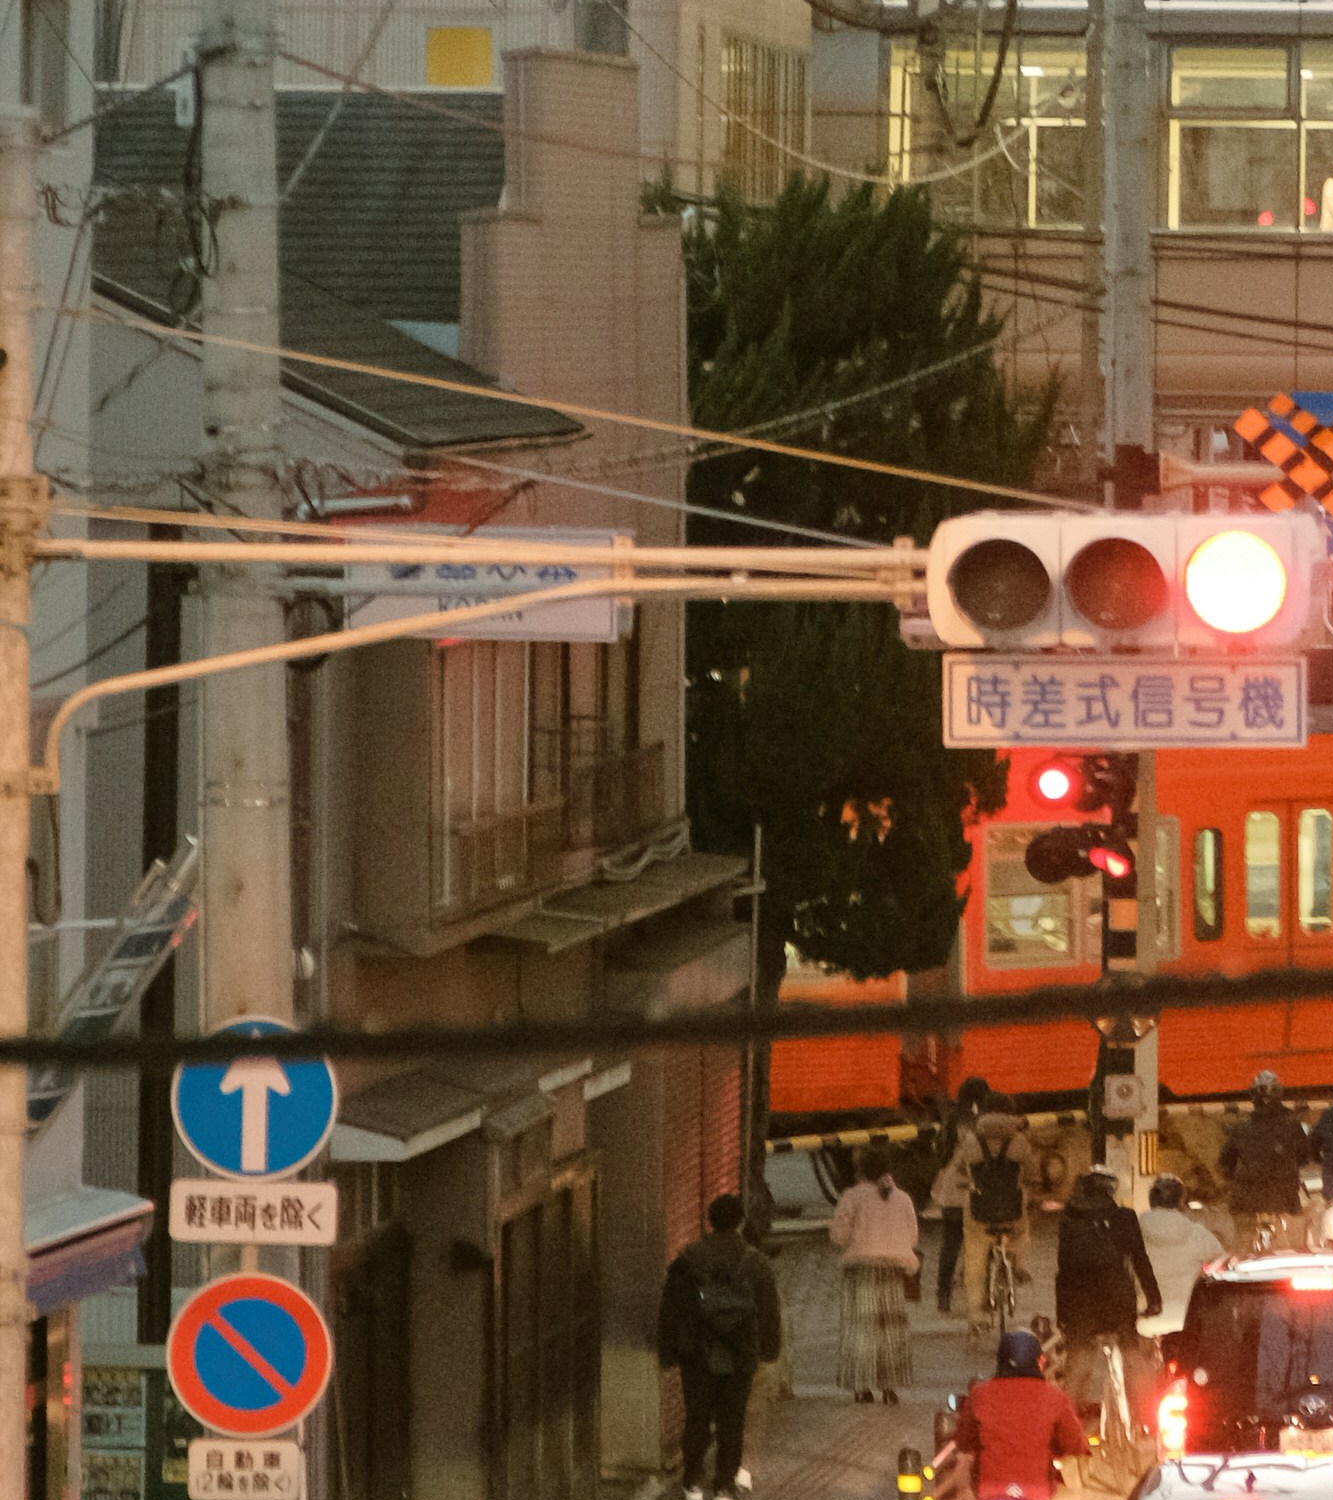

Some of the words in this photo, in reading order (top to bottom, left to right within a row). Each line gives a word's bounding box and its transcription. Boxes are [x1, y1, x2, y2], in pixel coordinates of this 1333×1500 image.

[966, 674, 1285, 729] 時差式信号機
[185, 1194, 323, 1231] 軽車両を除く
[206, 1449, 280, 1470] 自動車
